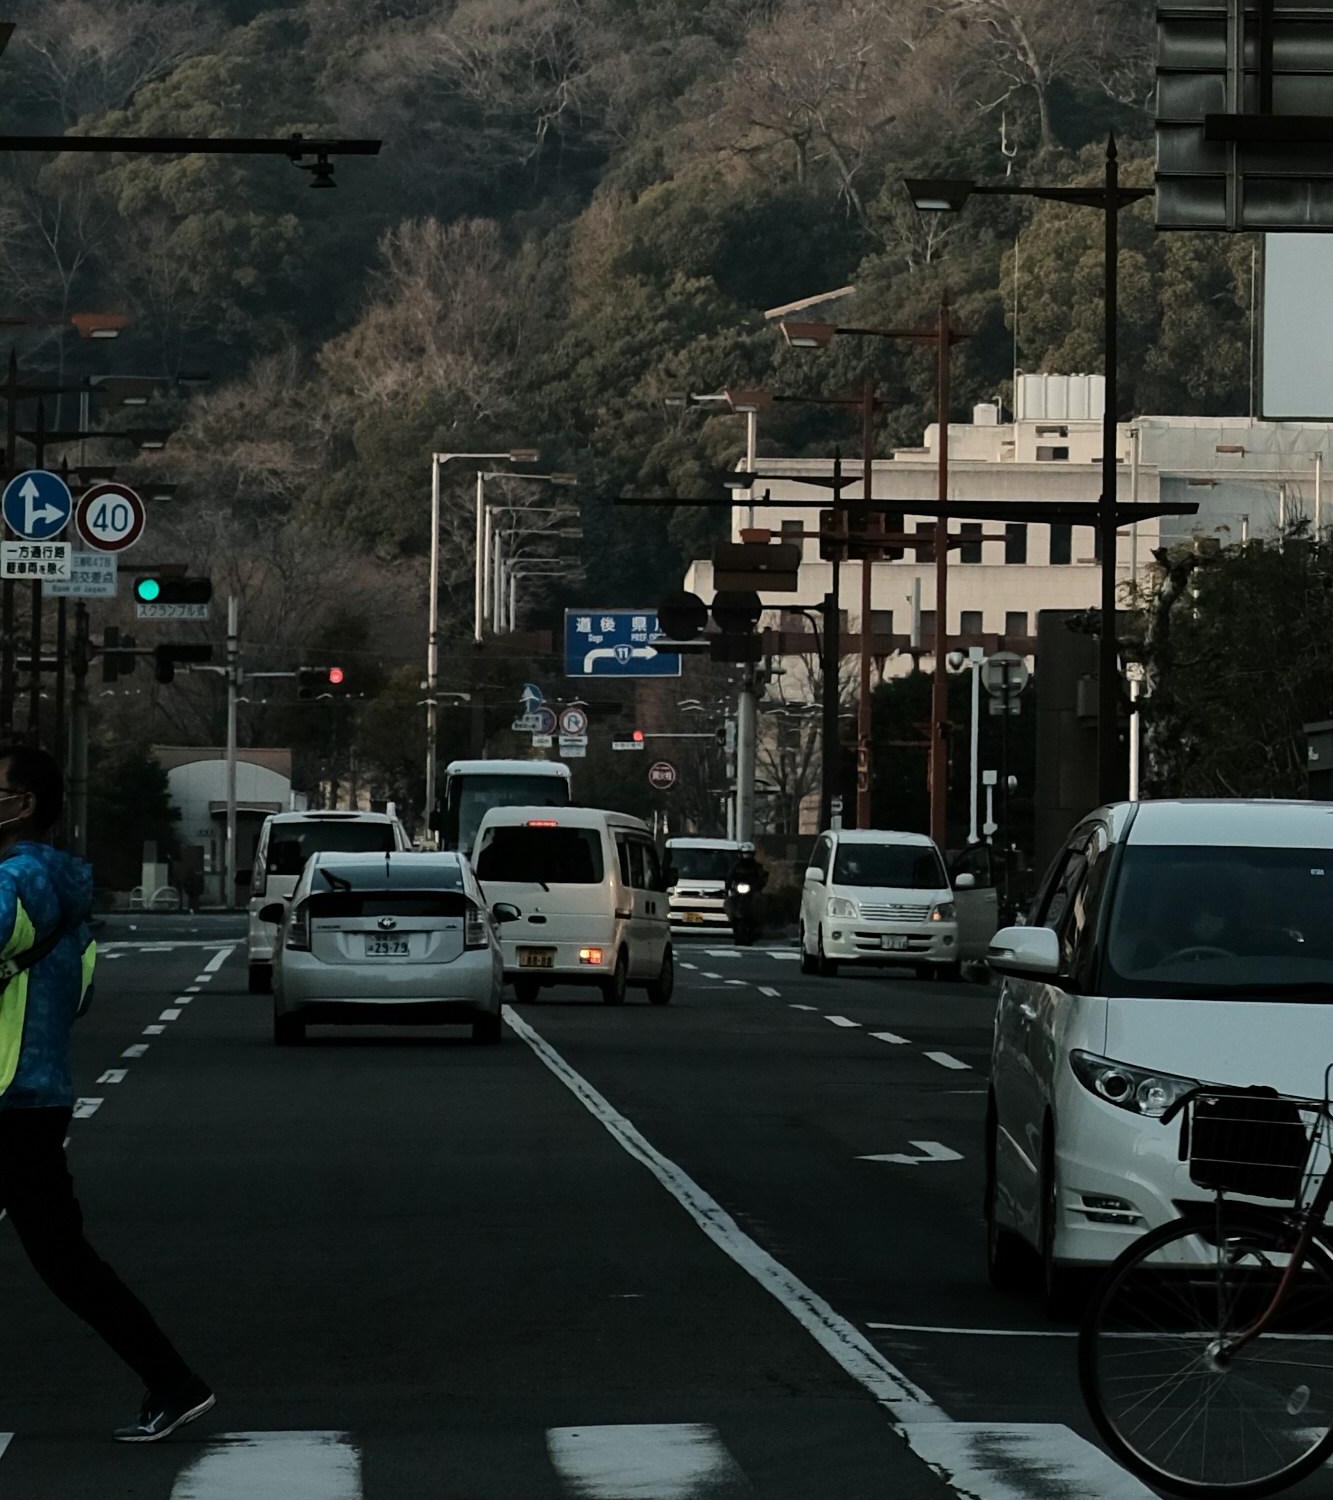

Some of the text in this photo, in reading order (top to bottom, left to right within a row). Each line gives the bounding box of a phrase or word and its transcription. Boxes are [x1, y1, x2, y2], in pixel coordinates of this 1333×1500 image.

[93, 503, 128, 532] 40
[7, 546, 66, 559] 一方通行路
[617, 647, 629, 660] 11
